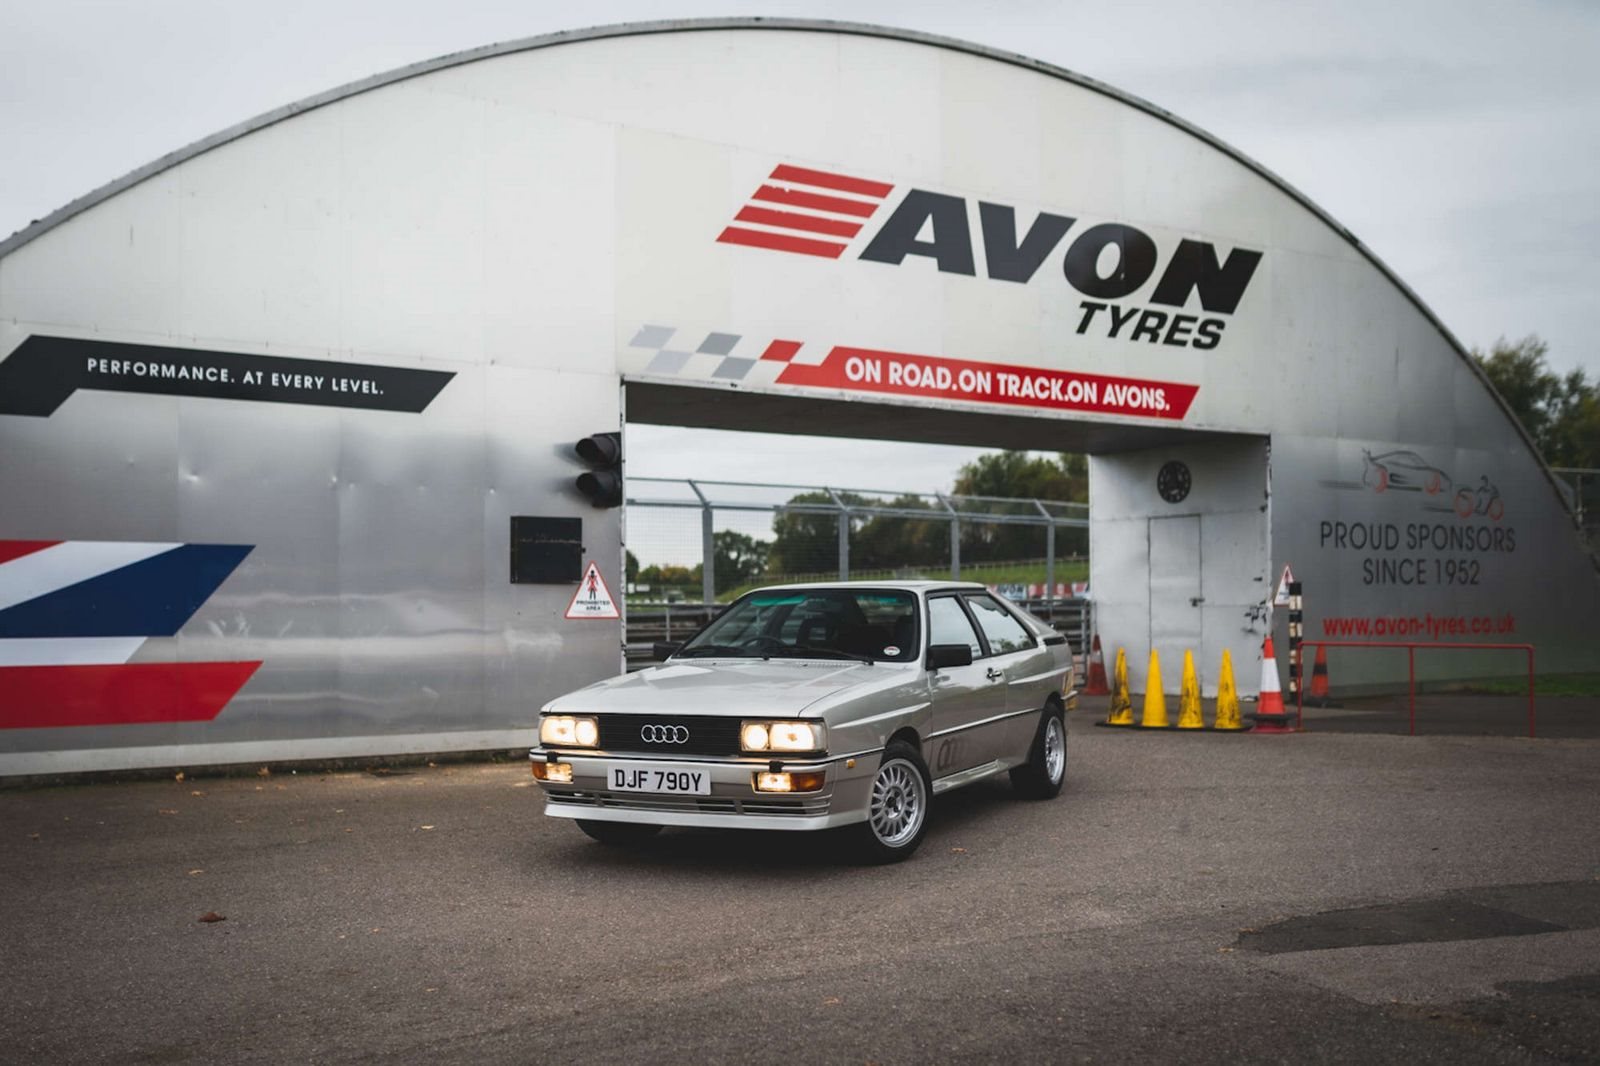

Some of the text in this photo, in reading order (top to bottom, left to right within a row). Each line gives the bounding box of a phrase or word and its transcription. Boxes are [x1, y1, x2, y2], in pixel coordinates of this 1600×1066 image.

[858, 188, 1264, 316] AVON
[1076, 301, 1226, 350] TYRES
[87, 358, 384, 395] PERFORMANCE. AT EVERY LEVEL.
[844, 356, 882, 384] ON
[1102, 383, 1170, 411] AVONS.
[1320, 521, 1516, 553] PROUD SPONSORS
[1362, 557, 1480, 586] SINCE 1952
[1323, 612, 1515, 639] www.avon-tyres.co.uk
[614, 768, 702, 793] DJF 790Y
